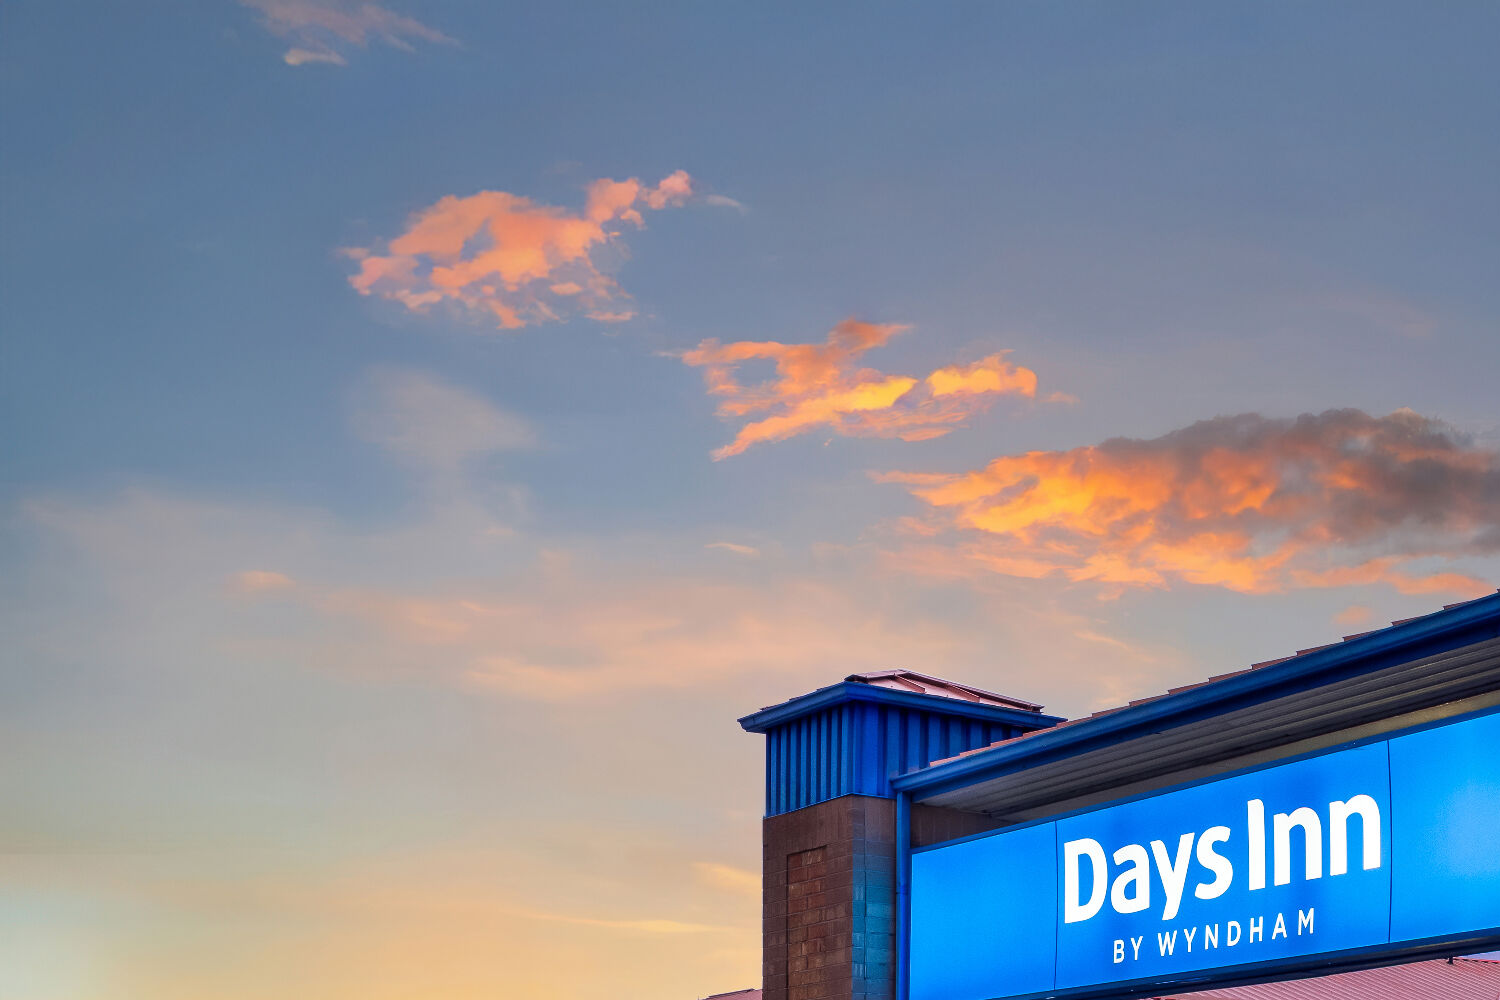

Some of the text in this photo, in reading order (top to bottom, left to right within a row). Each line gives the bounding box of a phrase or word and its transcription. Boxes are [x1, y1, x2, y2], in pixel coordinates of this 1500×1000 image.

[1063, 793, 1382, 924] Days Inn
[1112, 907, 1316, 964] BY WYNDHAM
